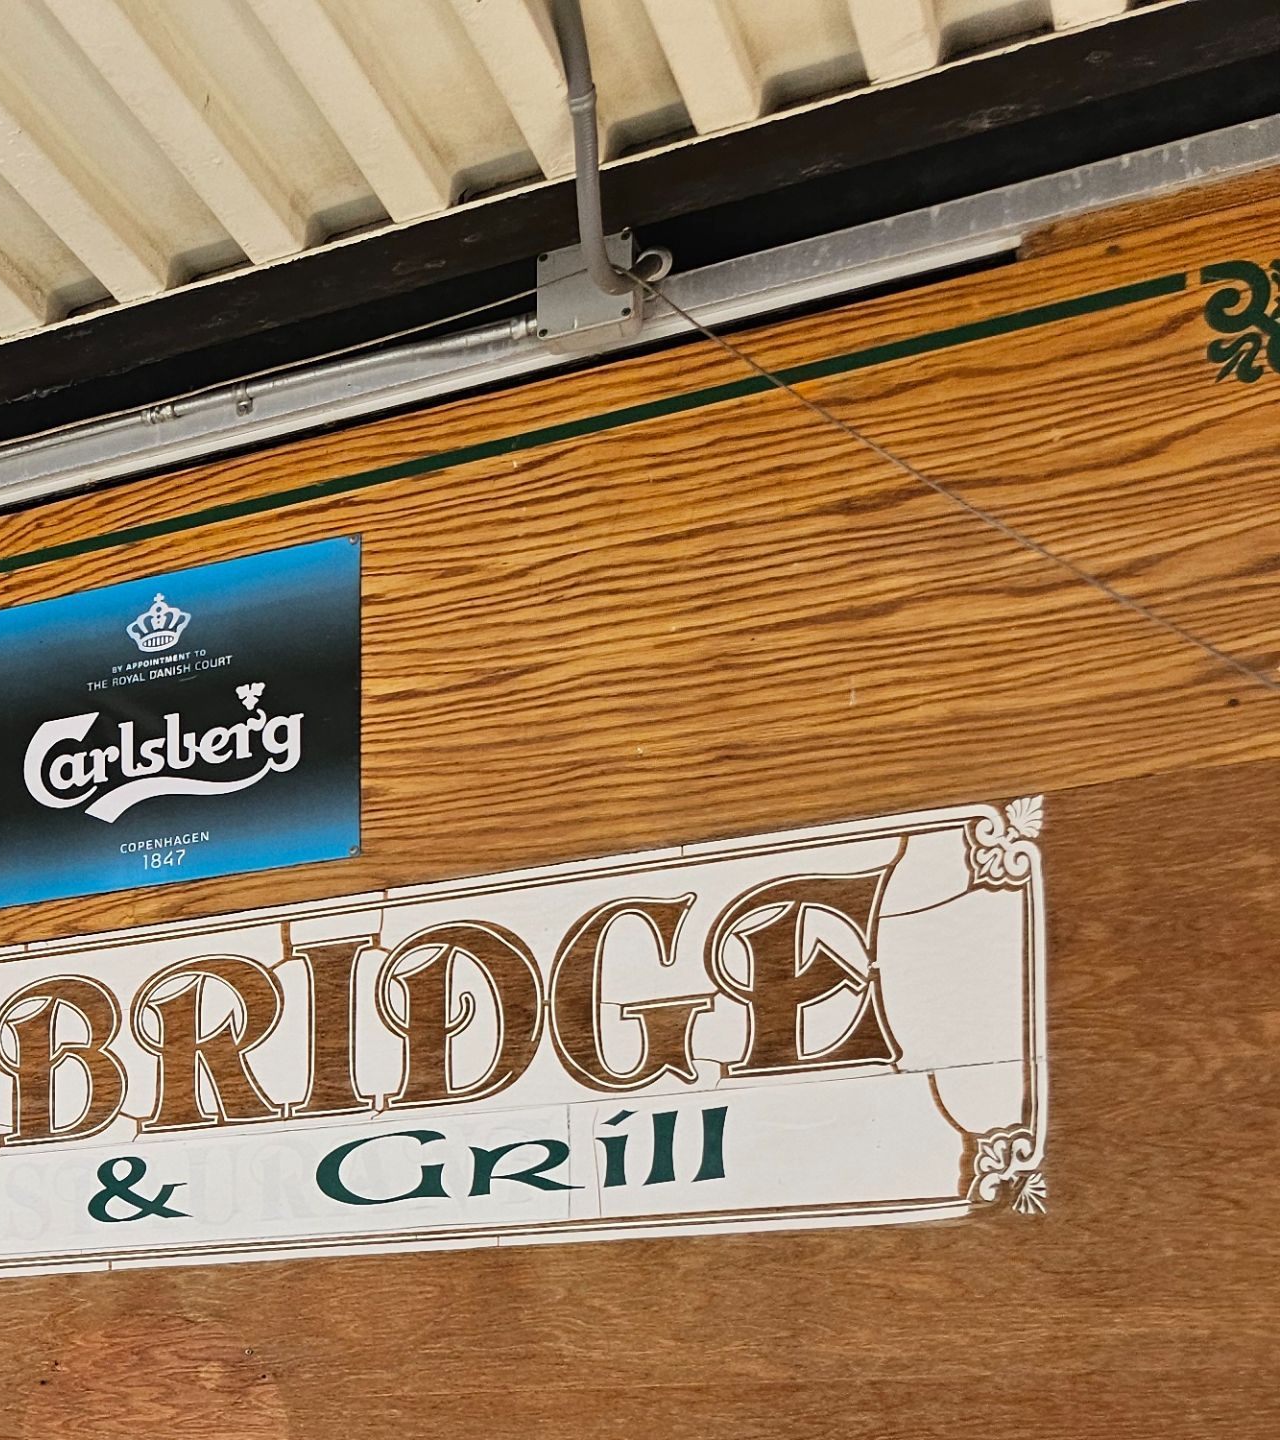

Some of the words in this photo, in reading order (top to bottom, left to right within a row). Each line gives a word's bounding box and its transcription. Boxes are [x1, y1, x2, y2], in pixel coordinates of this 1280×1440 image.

[86, 679, 109, 692] THE
[111, 672, 146, 687] ROYAL
[149, 663, 192, 681] DANISH
[194, 654, 234, 671] COURT
[111, 664, 124, 674] BY
[125, 651, 192, 672] APPOINTMENT
[194, 649, 207, 658] TO
[24, 706, 304, 823] Carlsberg
[120, 831, 210, 854] COPENHAGEN
[142, 849, 186, 871] 1847
[86, 1155, 194, 1224] &
[315, 1105, 730, 1206] Grill
